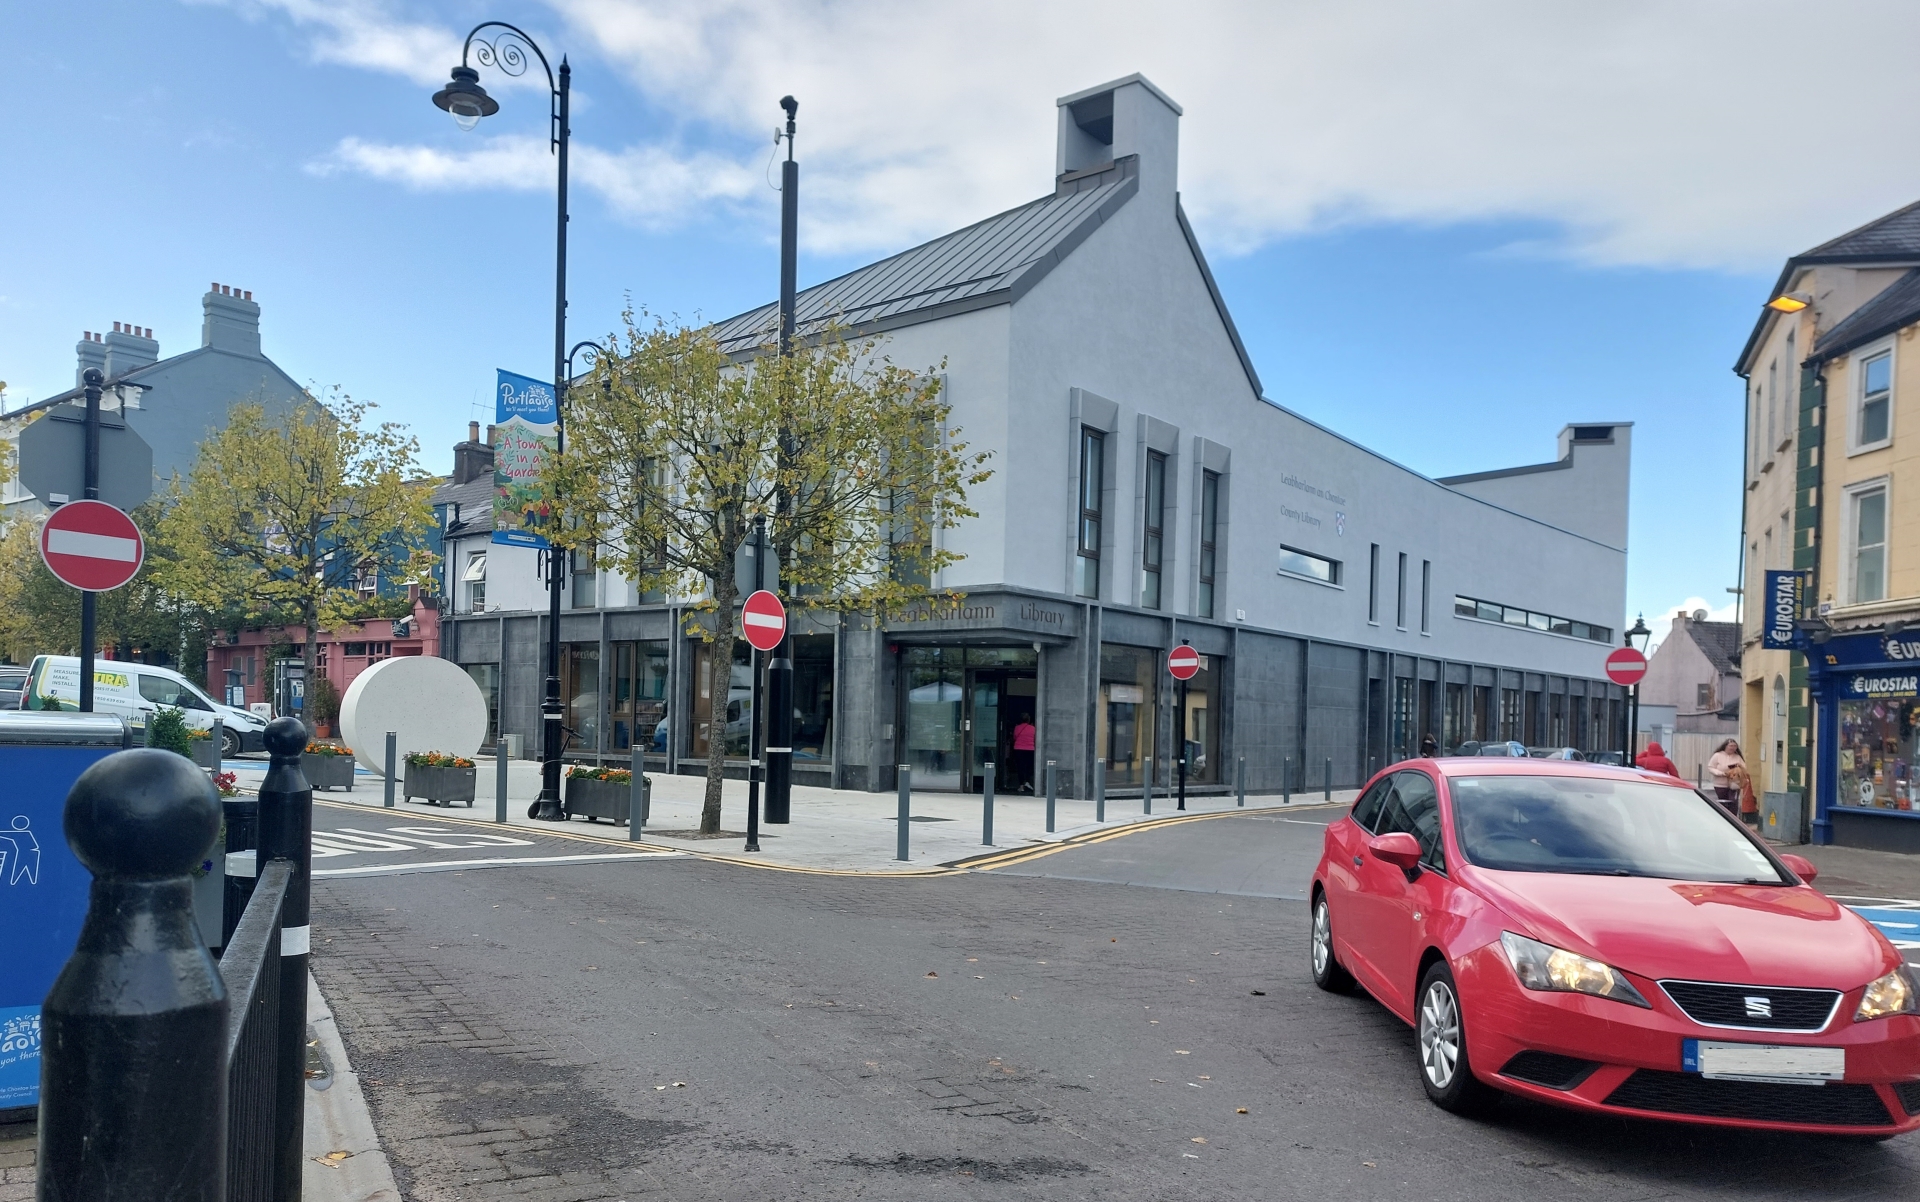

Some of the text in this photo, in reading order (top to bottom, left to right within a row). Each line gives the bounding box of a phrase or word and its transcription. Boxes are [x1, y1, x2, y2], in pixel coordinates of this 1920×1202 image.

[500, 382, 554, 408] Portlaoise
[504, 436, 512, 449] A
[516, 450, 541, 464] in a
[505, 463, 541, 478] Garde
[1280, 504, 1321, 530] County Library
[1020, 602, 1065, 629] Library
[94, 672, 125, 688] TIRA
[0, 1056, 16, 1069] you
[1684, 1057, 1697, 1066] IRL
